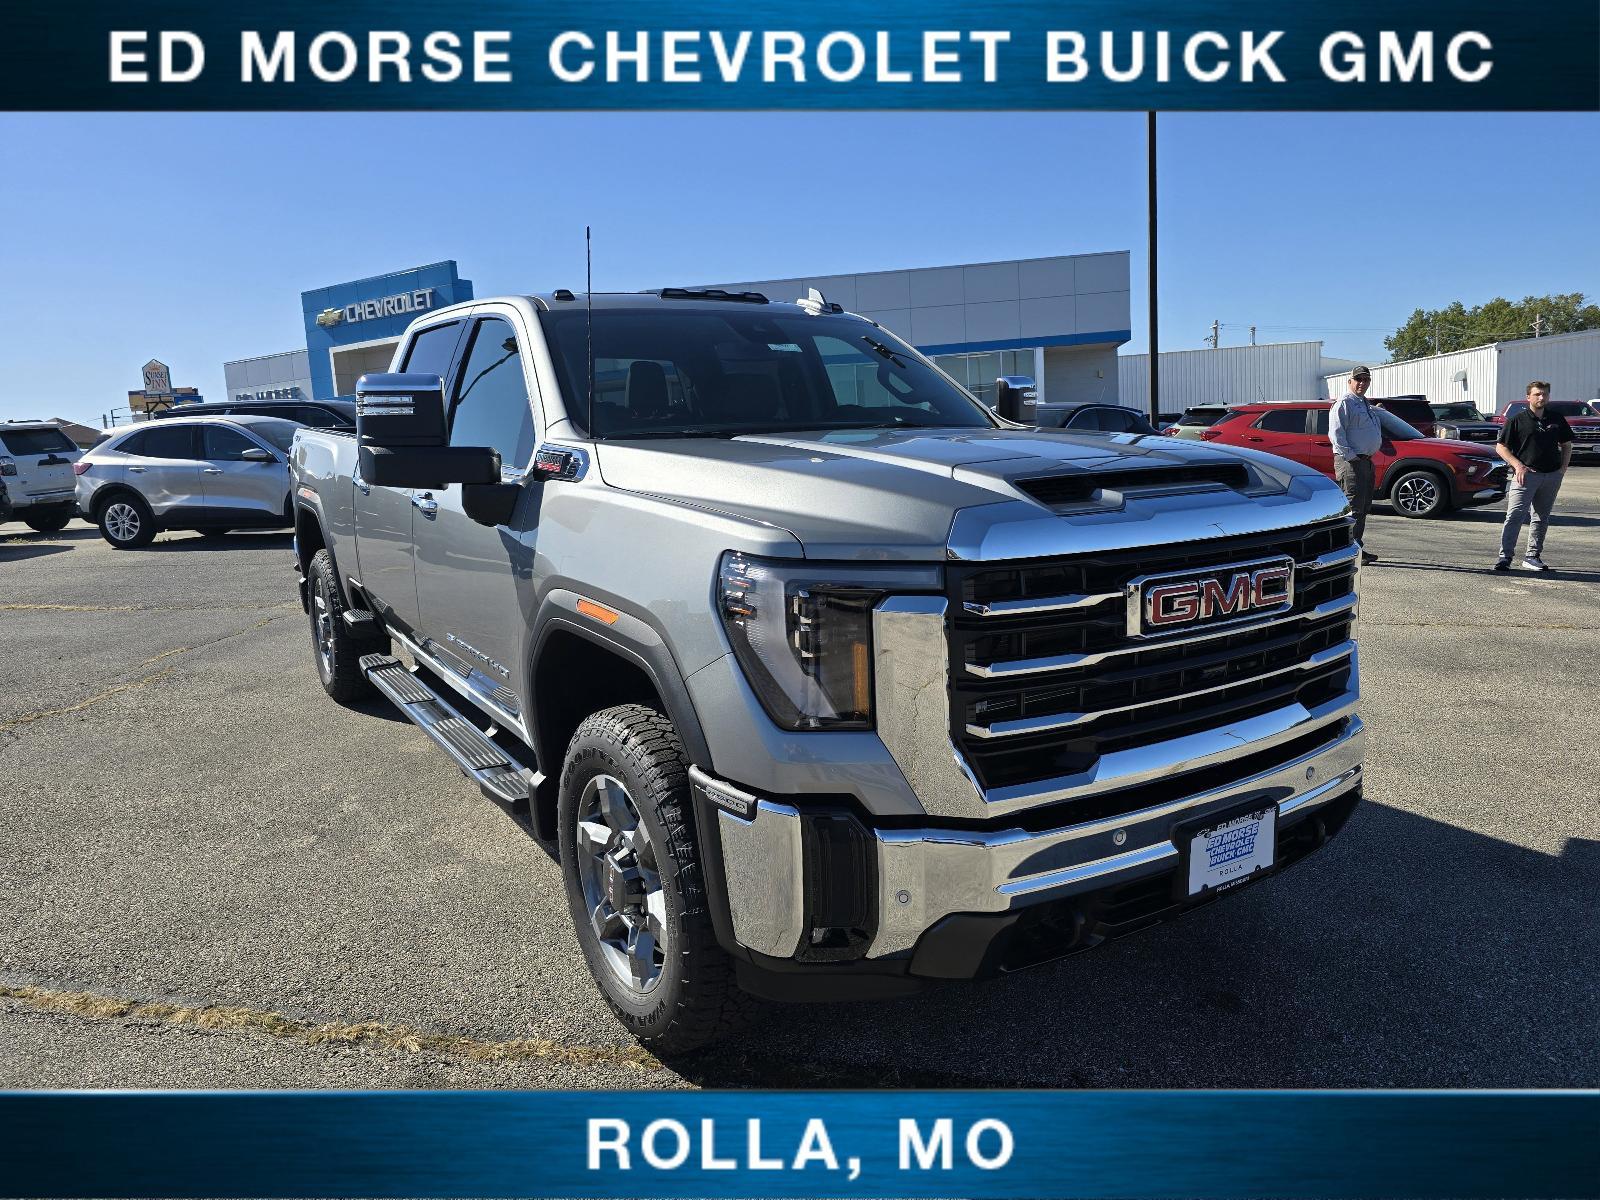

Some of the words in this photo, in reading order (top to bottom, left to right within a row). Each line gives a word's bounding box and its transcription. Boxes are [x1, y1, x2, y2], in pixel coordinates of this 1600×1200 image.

[346, 288, 434, 323] CHEVROLET
[152, 378, 168, 389] INN
[1147, 567, 1290, 626] GMC
[1207, 834, 1222, 850] ED
[1221, 822, 1259, 843] MORSE
[1209, 835, 1255, 857] CHEVROLET
[1219, 864, 1243, 877] ROLLA
